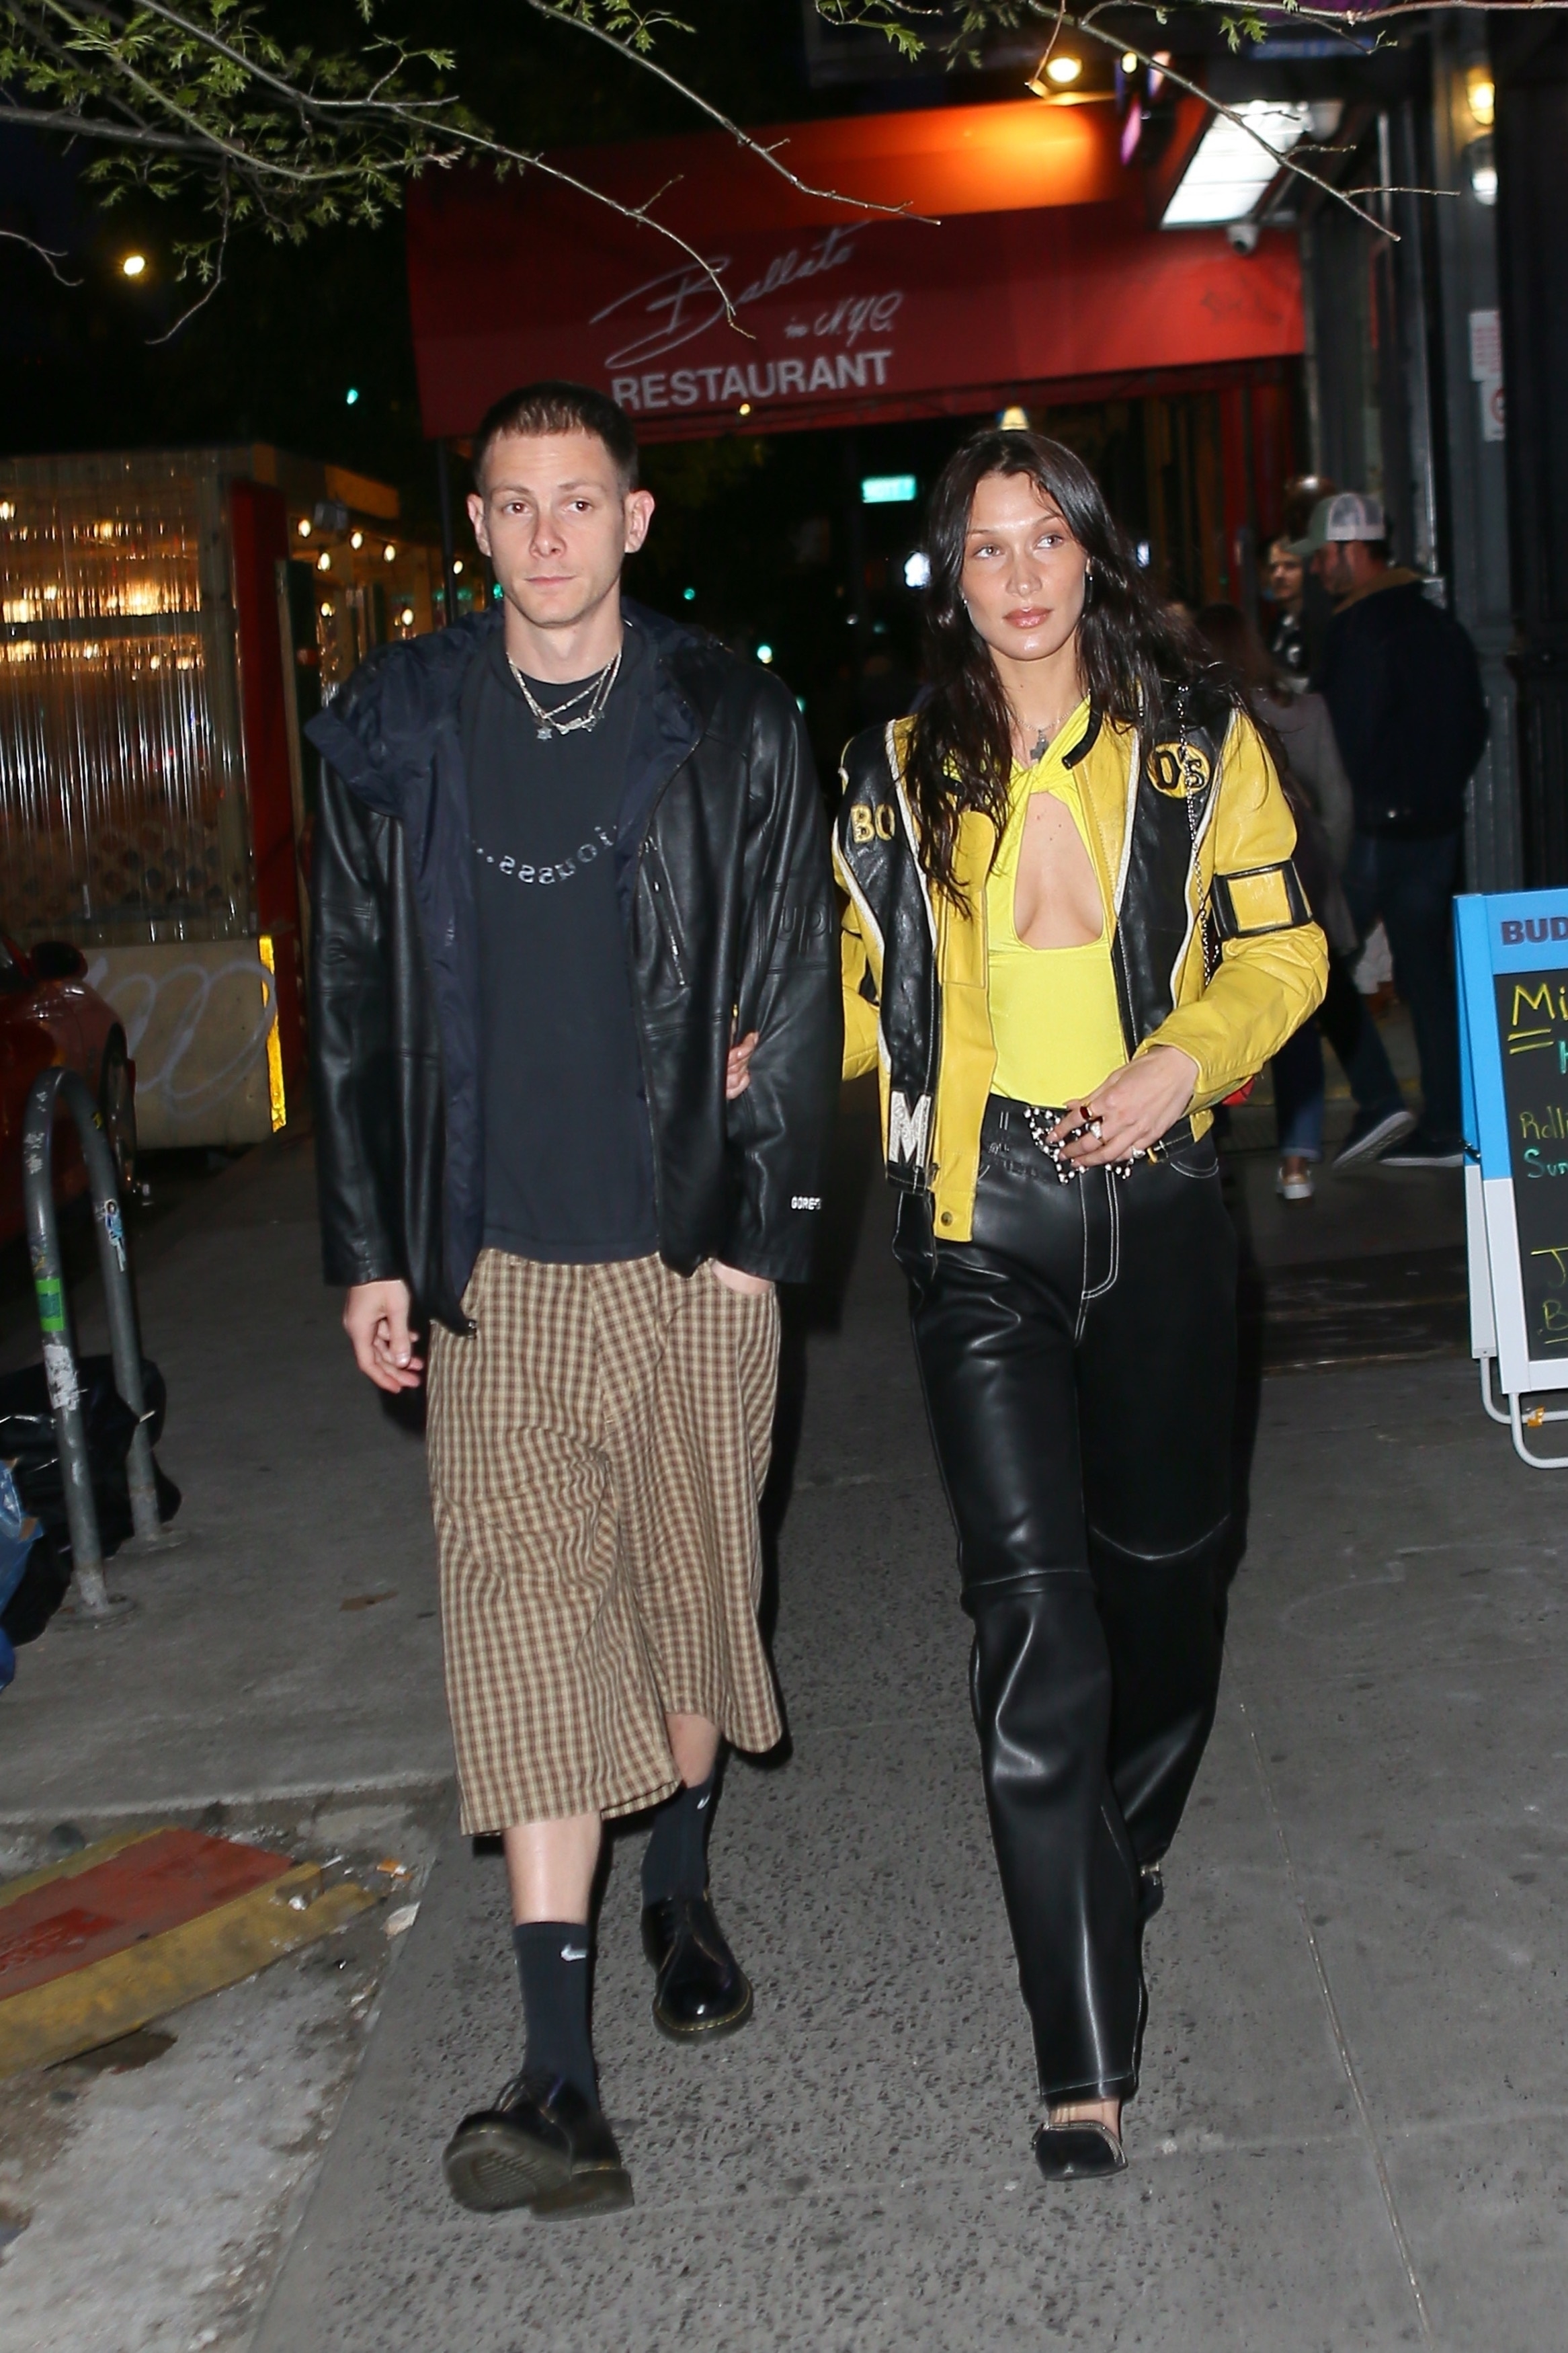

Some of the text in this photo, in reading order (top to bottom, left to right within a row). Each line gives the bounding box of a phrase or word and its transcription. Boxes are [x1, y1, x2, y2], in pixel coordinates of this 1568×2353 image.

[611, 350, 893, 411] RESTAURANT
[1500, 916, 1568, 946] BUD
[888, 1089, 932, 1168] M
